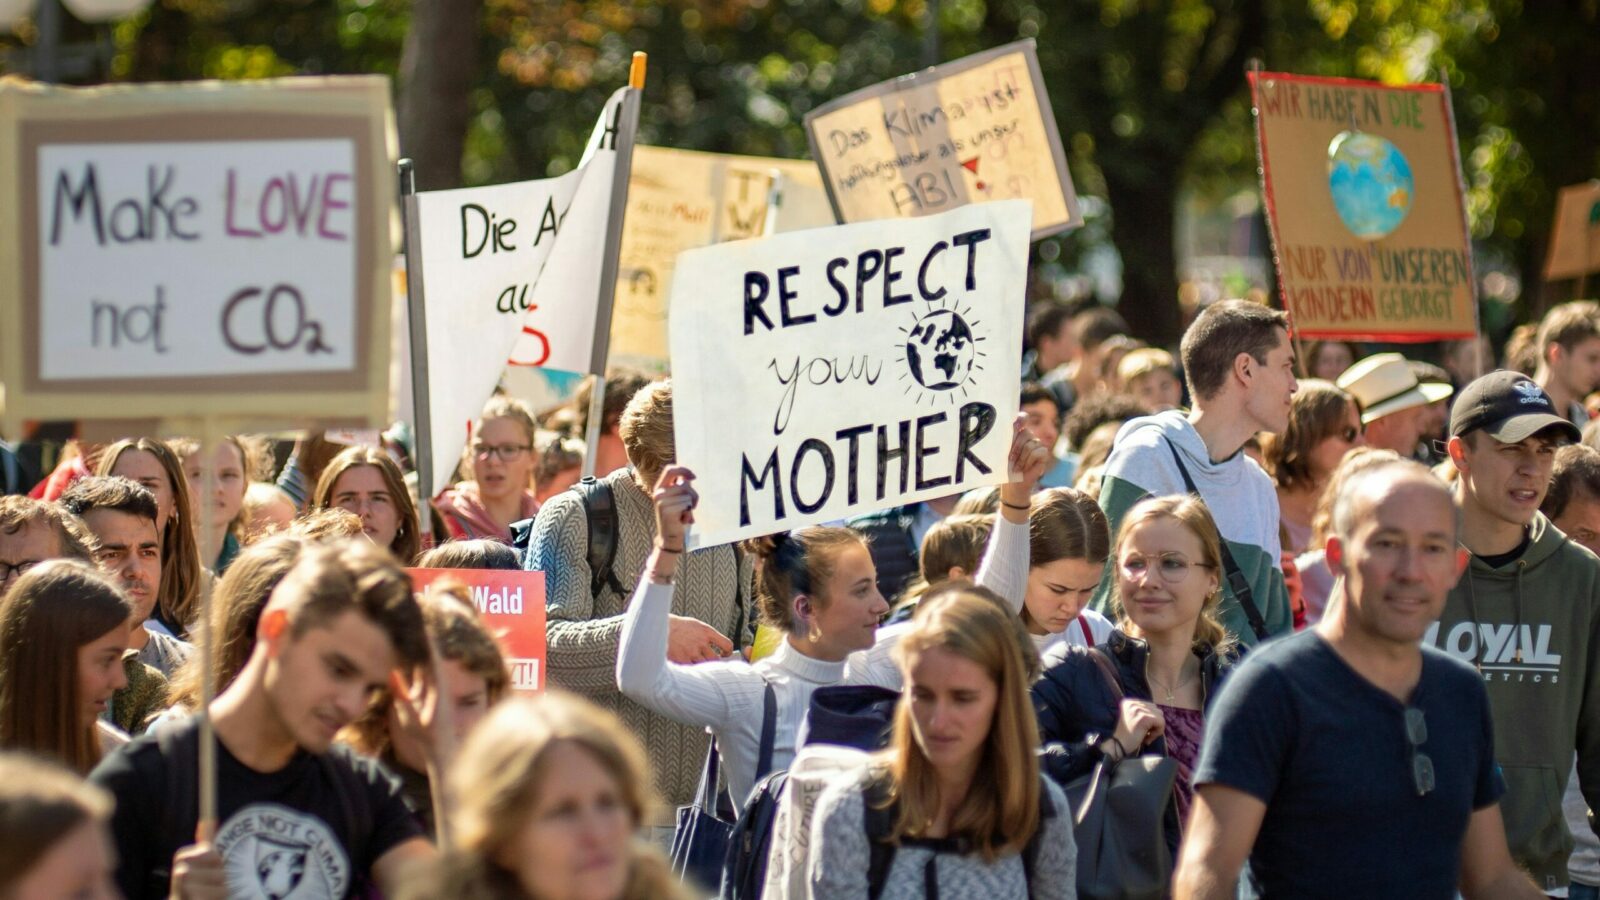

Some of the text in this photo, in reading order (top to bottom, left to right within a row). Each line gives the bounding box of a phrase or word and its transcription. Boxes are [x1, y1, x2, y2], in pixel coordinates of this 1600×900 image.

[828, 82, 1021, 157] Das Klima ist
[1260, 84, 1425, 130] WIR HABEN DIE
[50, 161, 352, 247] Make LOVE
[460, 203, 517, 259] Die
[533, 194, 572, 248] A
[743, 228, 992, 337] RESPECT
[1284, 245, 1468, 286] NUR VON UNSEREN
[90, 284, 170, 354] not
[1290, 287, 1454, 322] KINDERN GEBORGT
[767, 354, 884, 436] your
[738, 401, 998, 528] MOTHER
[469, 584, 523, 615] Wald
[1483, 672, 1559, 685] ETICS
[257, 813, 302, 837] NOT
[305, 829, 346, 897] CLIMA
